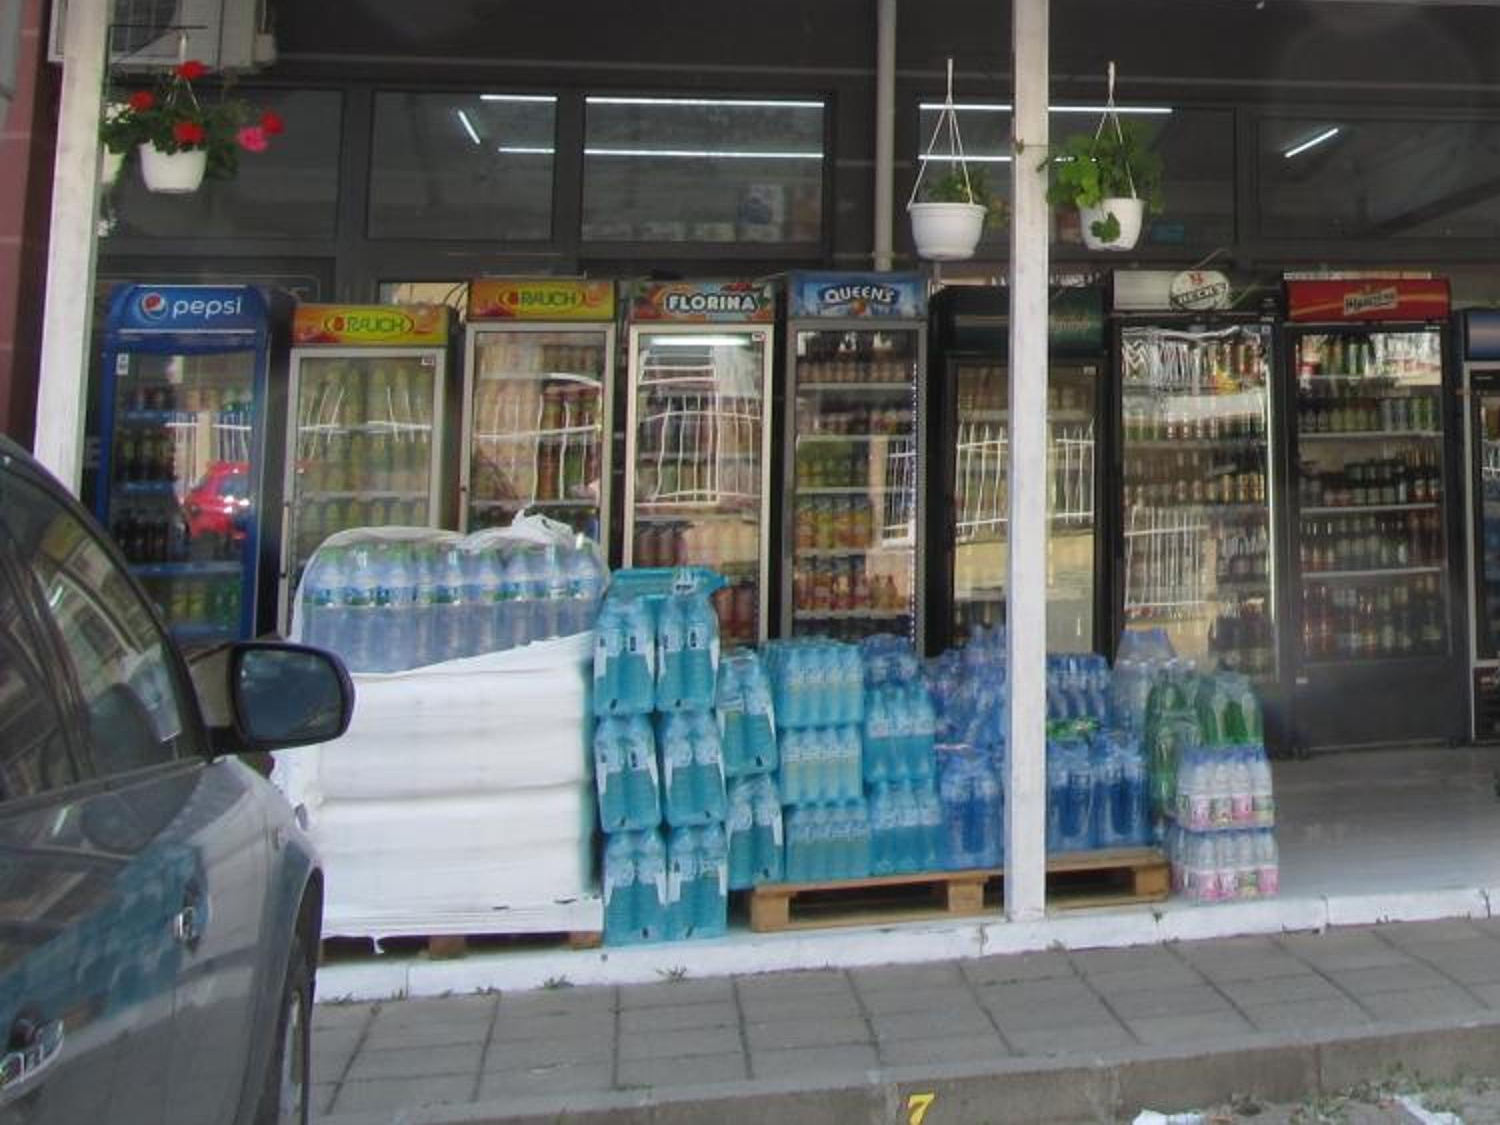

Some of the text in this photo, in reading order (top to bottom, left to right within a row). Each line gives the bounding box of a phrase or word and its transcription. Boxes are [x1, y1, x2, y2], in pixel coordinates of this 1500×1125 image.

[172, 295, 242, 320] pepsi
[521, 289, 577, 307] RAUCH
[668, 295, 756, 312] FLORINA
[907, 1092, 935, 1125] 7
